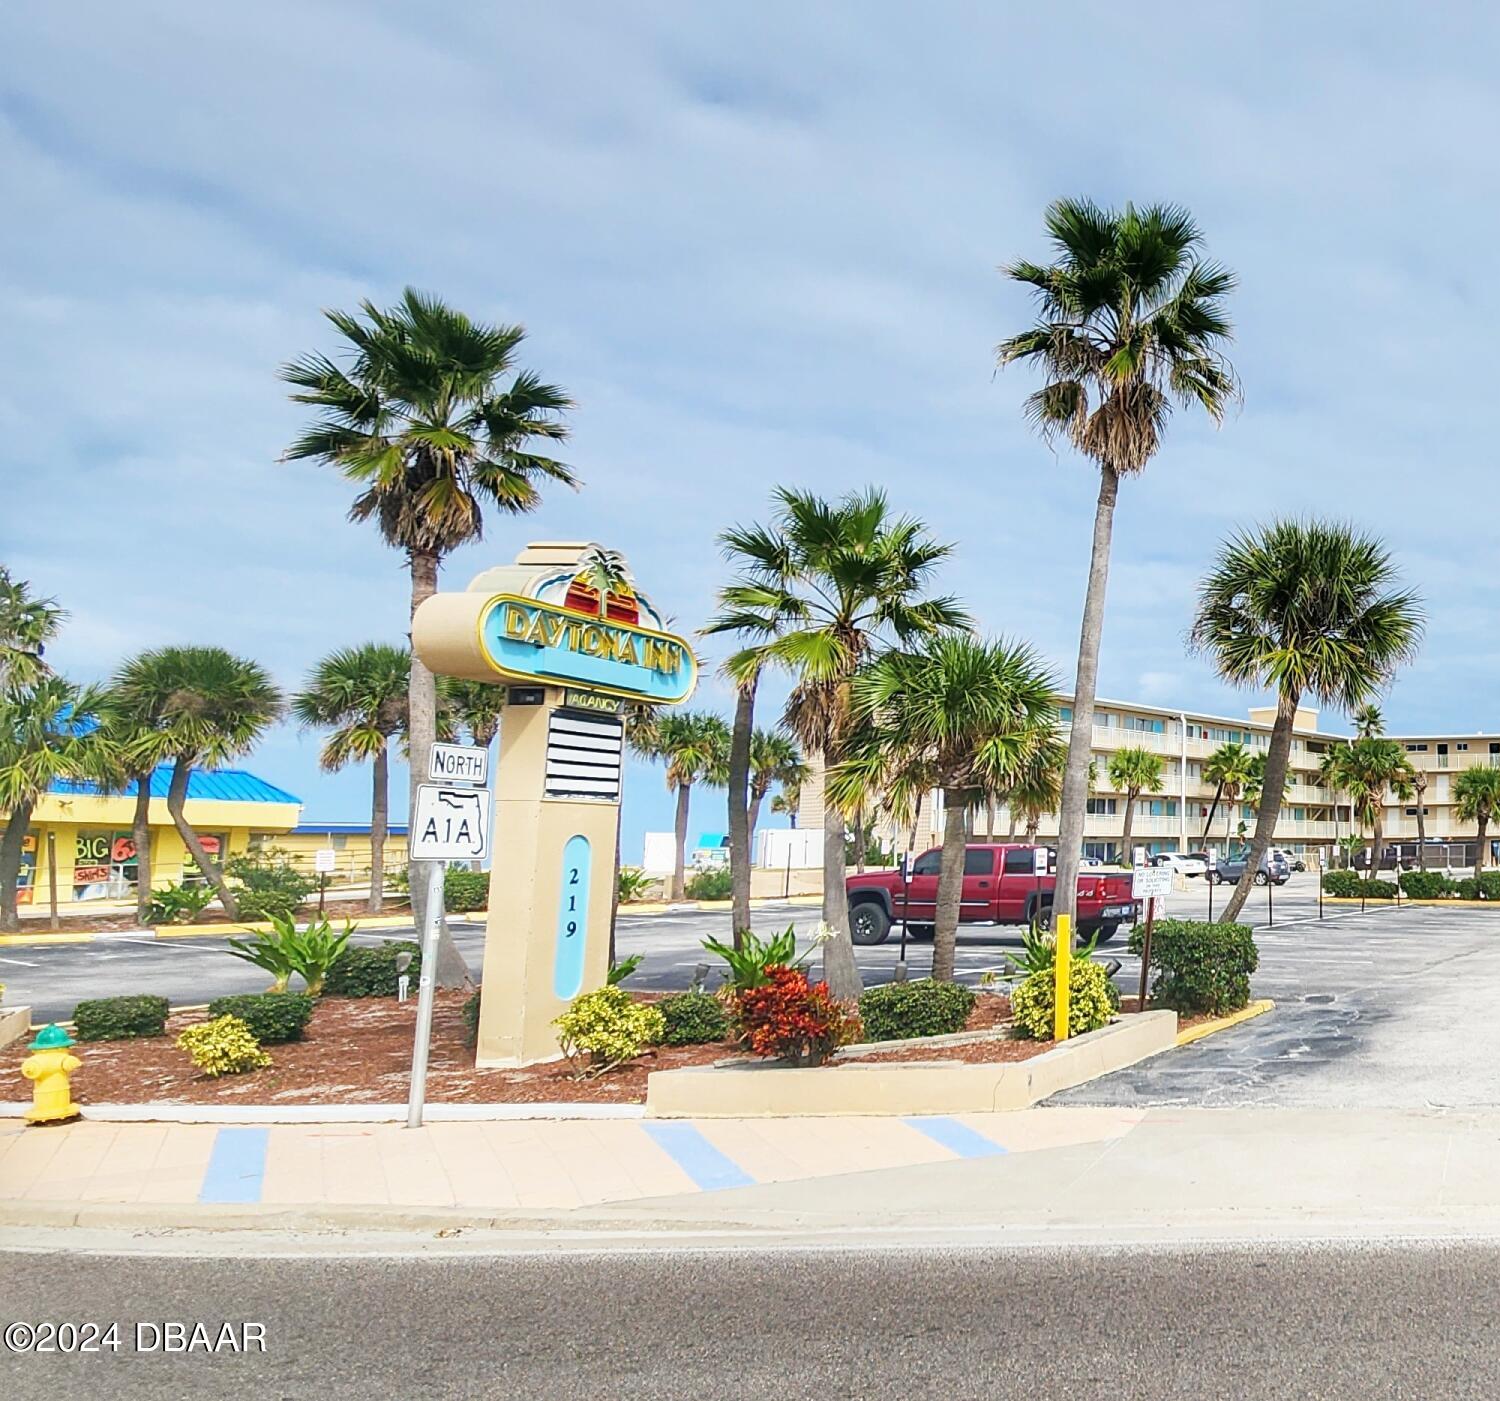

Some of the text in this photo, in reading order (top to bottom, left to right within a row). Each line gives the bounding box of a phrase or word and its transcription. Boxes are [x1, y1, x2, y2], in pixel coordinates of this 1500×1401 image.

[504, 603, 683, 674] DAYTONA INN
[434, 750, 483, 776] NORTH
[421, 816, 472, 844] A1A
[75, 837, 109, 859] BIG
